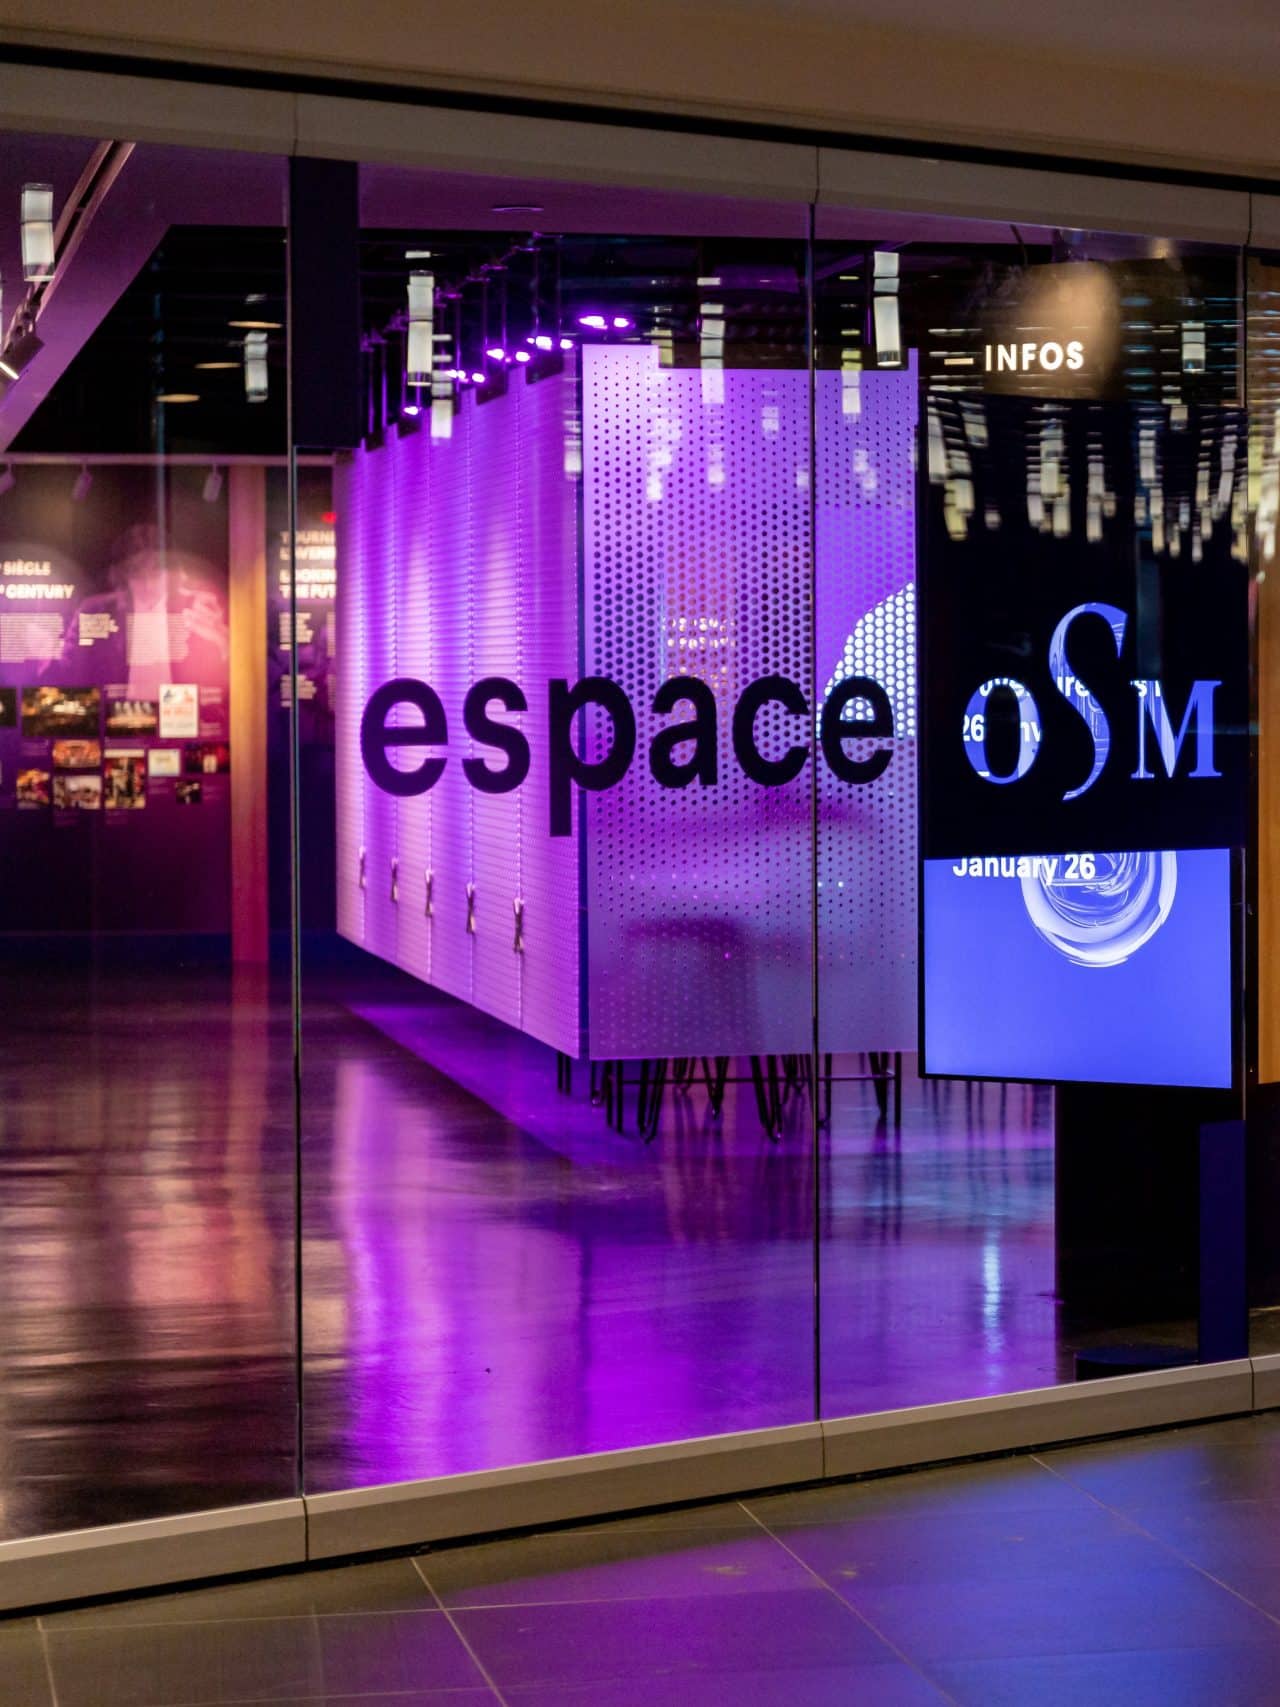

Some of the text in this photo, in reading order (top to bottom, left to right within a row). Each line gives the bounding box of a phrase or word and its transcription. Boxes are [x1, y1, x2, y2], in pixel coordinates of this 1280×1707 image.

[985, 341, 1084, 371] INFOS
[5, 584, 75, 600] CENTURY
[360, 675, 894, 837] espace
[953, 853, 1095, 886] January 26
